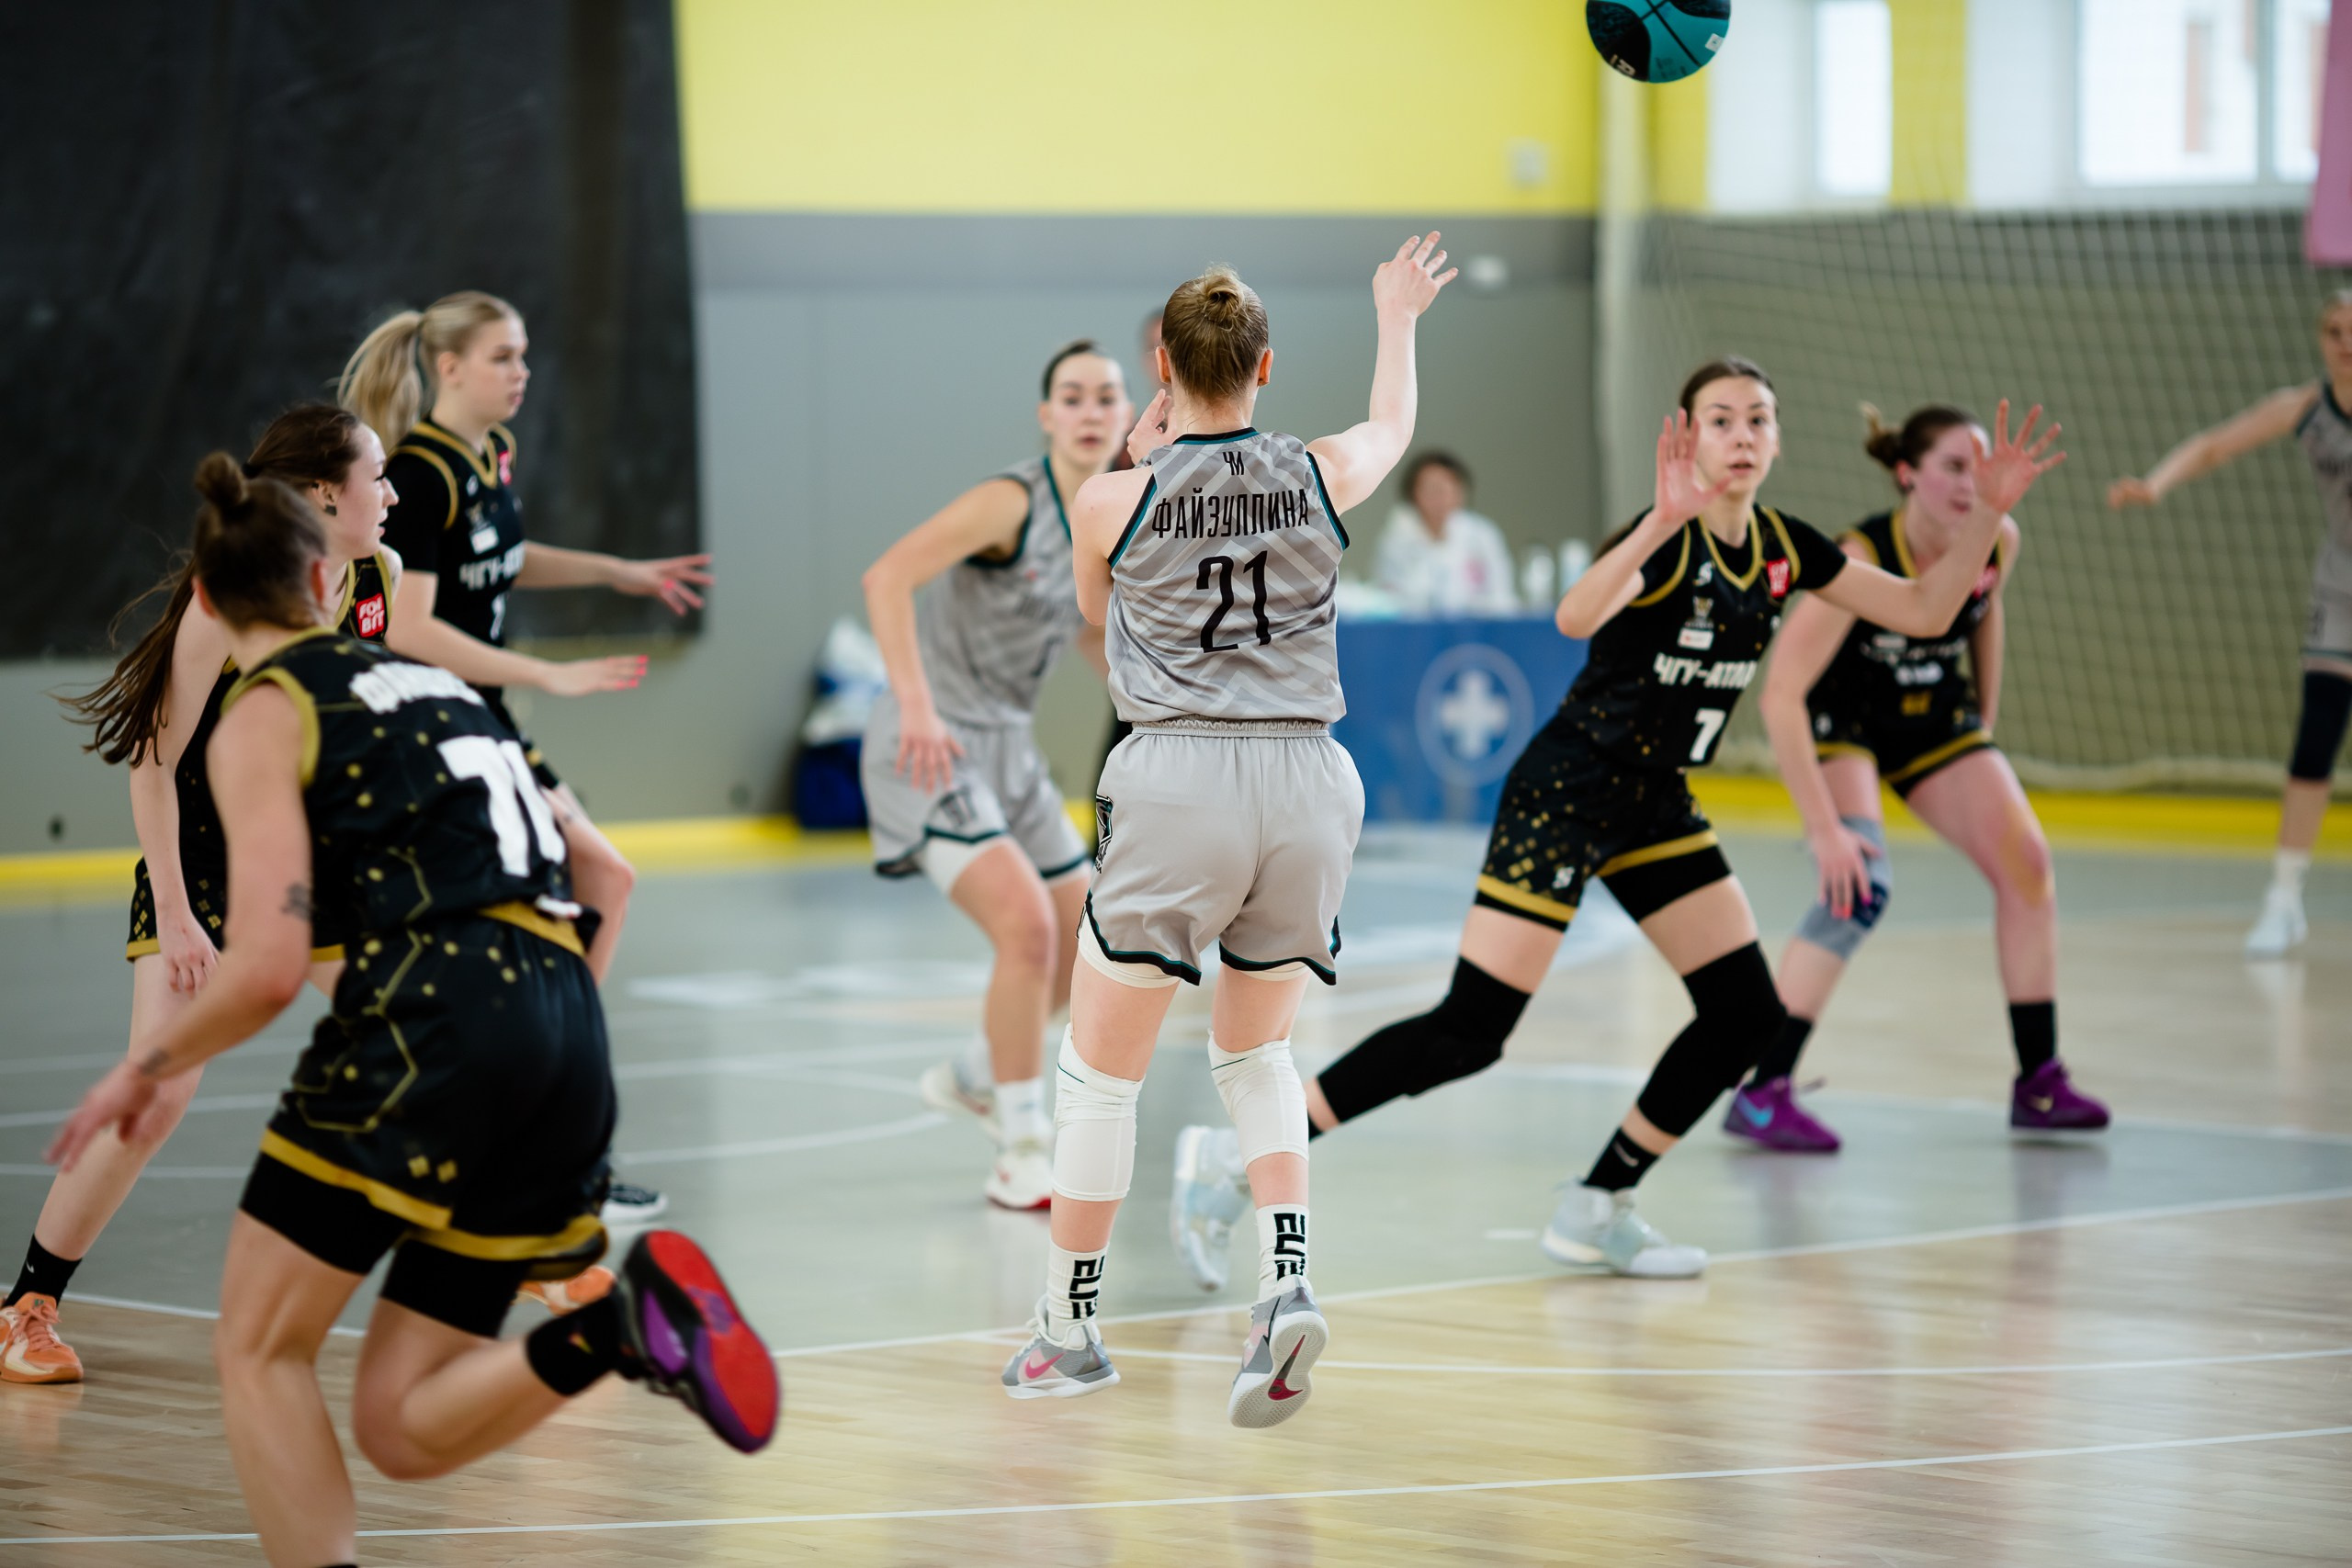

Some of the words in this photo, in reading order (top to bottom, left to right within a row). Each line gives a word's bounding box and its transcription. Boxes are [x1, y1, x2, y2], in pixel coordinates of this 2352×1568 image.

[1151, 487, 1310, 539] ФАЙЗУЛЛИНА
[1196, 549, 1272, 654] 21
[1690, 708, 1726, 761] 7
